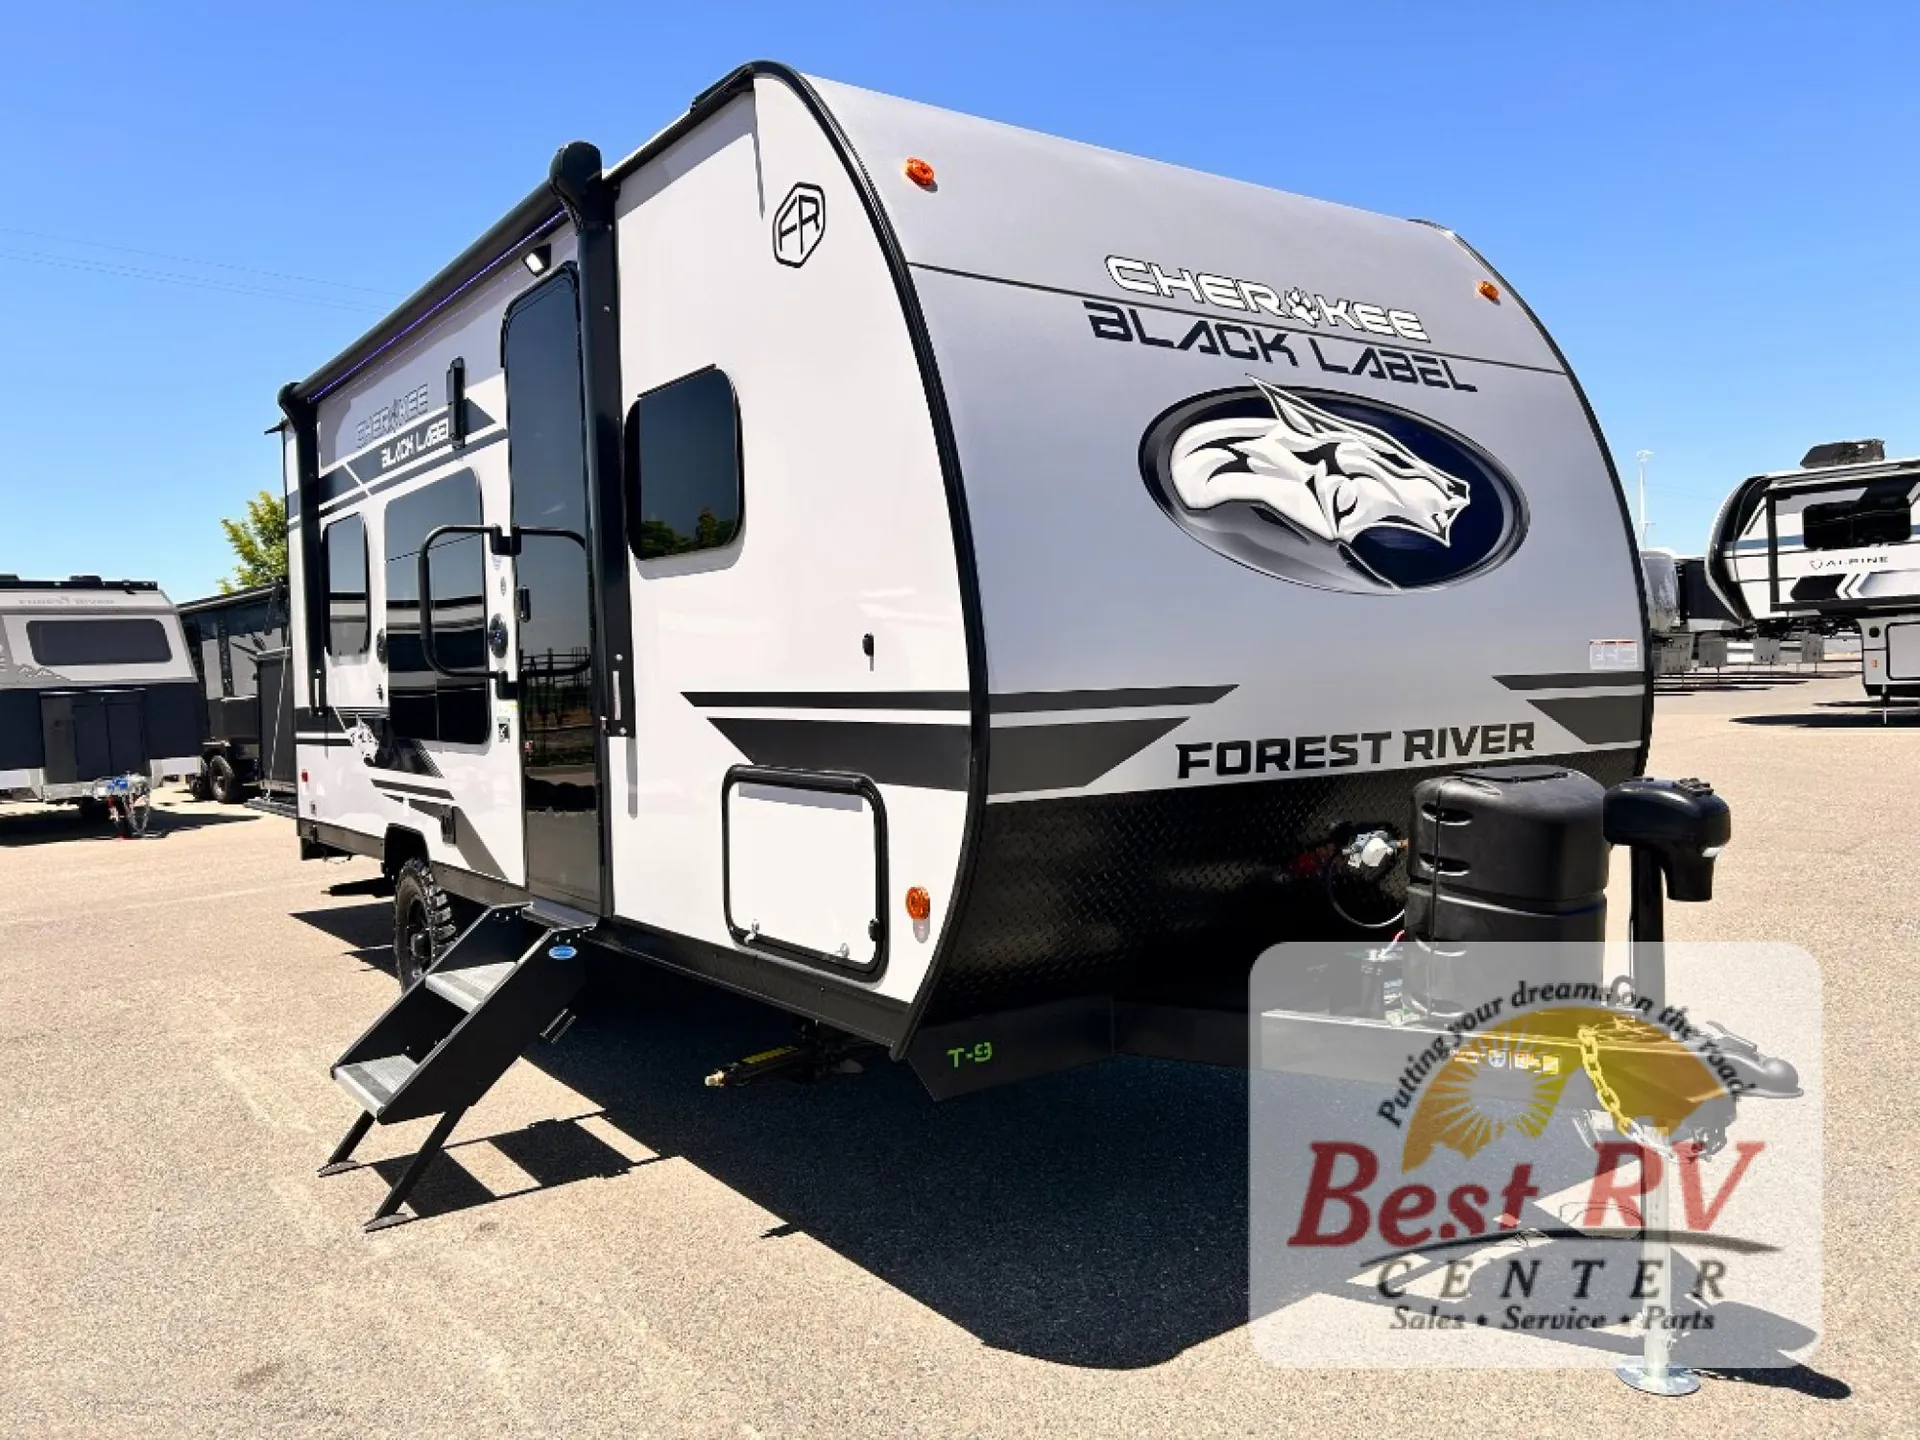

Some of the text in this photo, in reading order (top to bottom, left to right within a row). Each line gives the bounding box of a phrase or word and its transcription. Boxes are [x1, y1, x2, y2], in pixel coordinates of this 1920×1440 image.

[1103, 254, 1431, 344] CHEROKEE
[1082, 300, 1478, 393] BLACK LABEL
[380, 434, 415, 469] BLACK
[1825, 555, 1889, 567] ALPINE
[1175, 721, 1535, 779] FOREST RIVER
[946, 1041, 993, 1069] T-9
